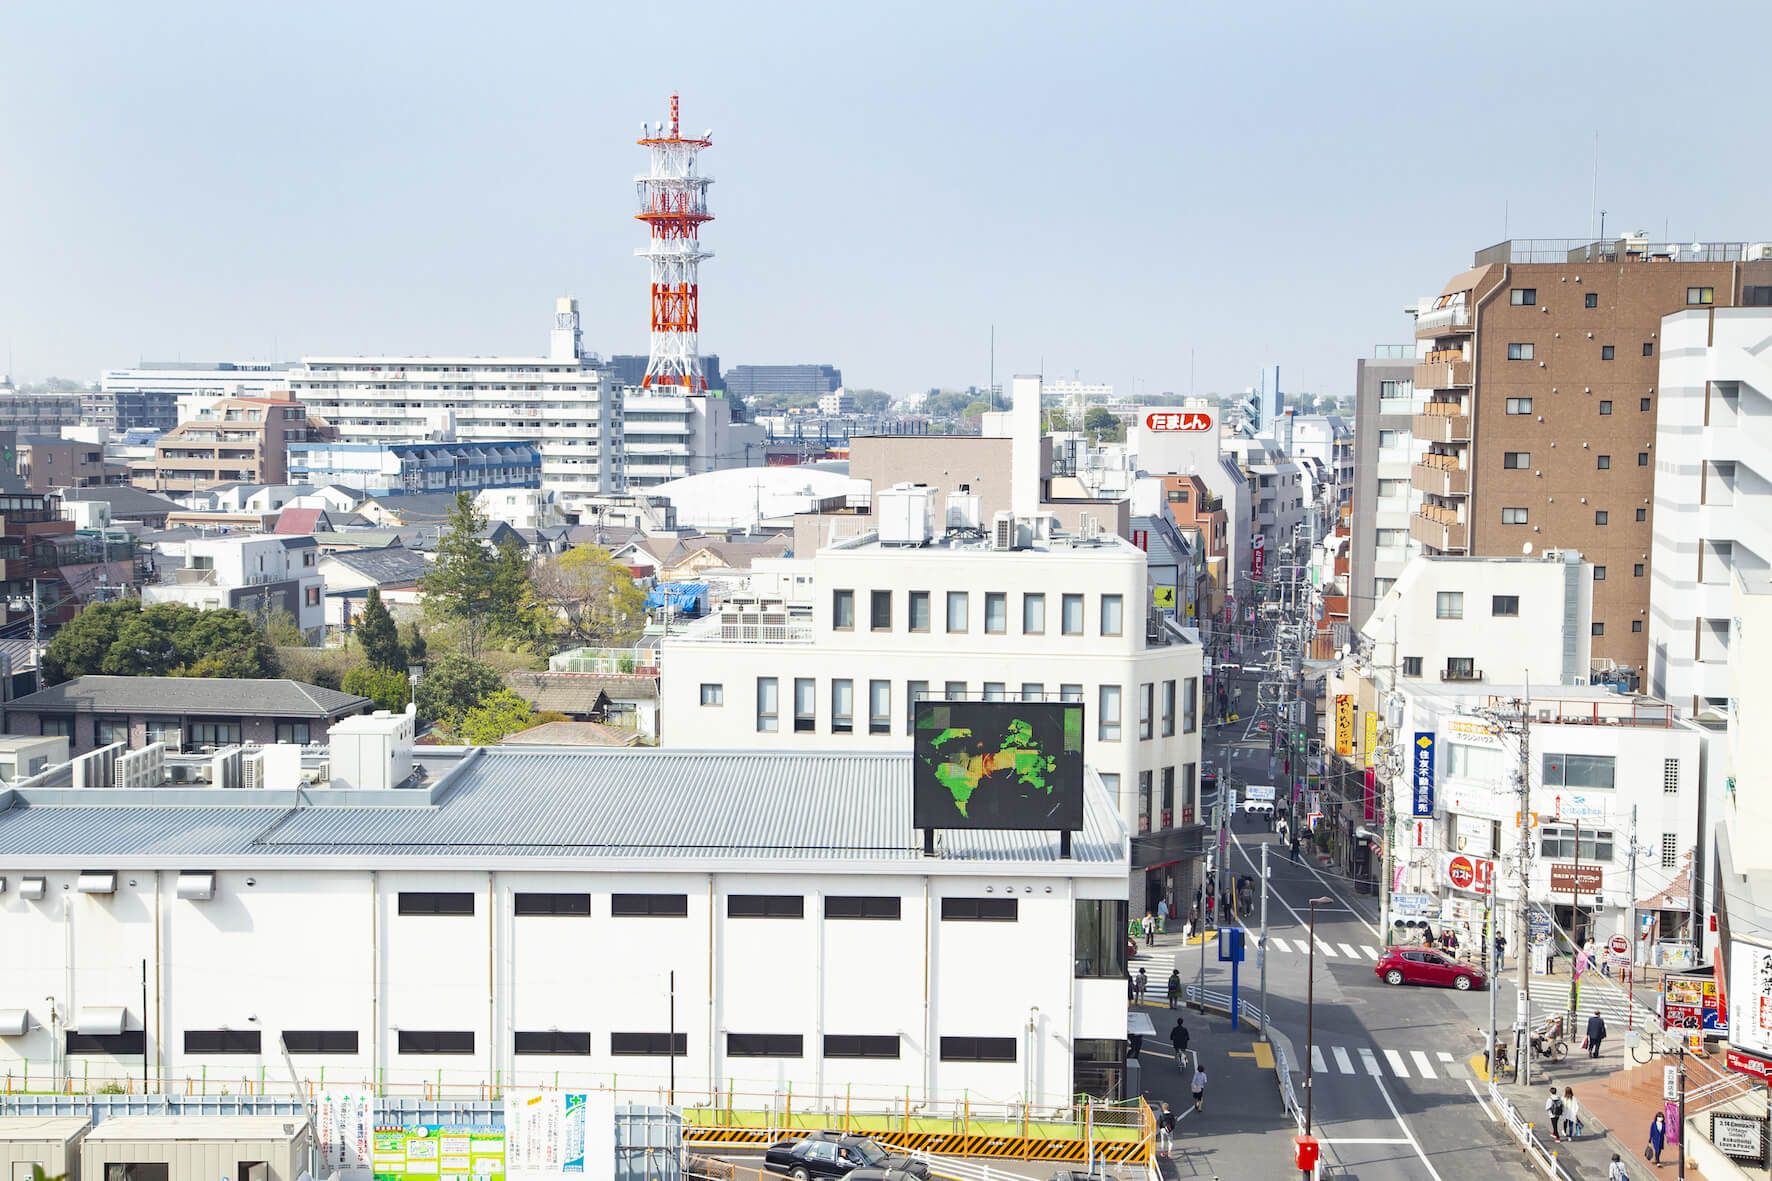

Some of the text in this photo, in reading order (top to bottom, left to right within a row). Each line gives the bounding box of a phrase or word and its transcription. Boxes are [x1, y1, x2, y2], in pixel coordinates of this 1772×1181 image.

[1151, 414, 1207, 430] たましん
[1418, 750, 1429, 812] 住友不動産販売
[1451, 869, 1472, 881] ガスト
